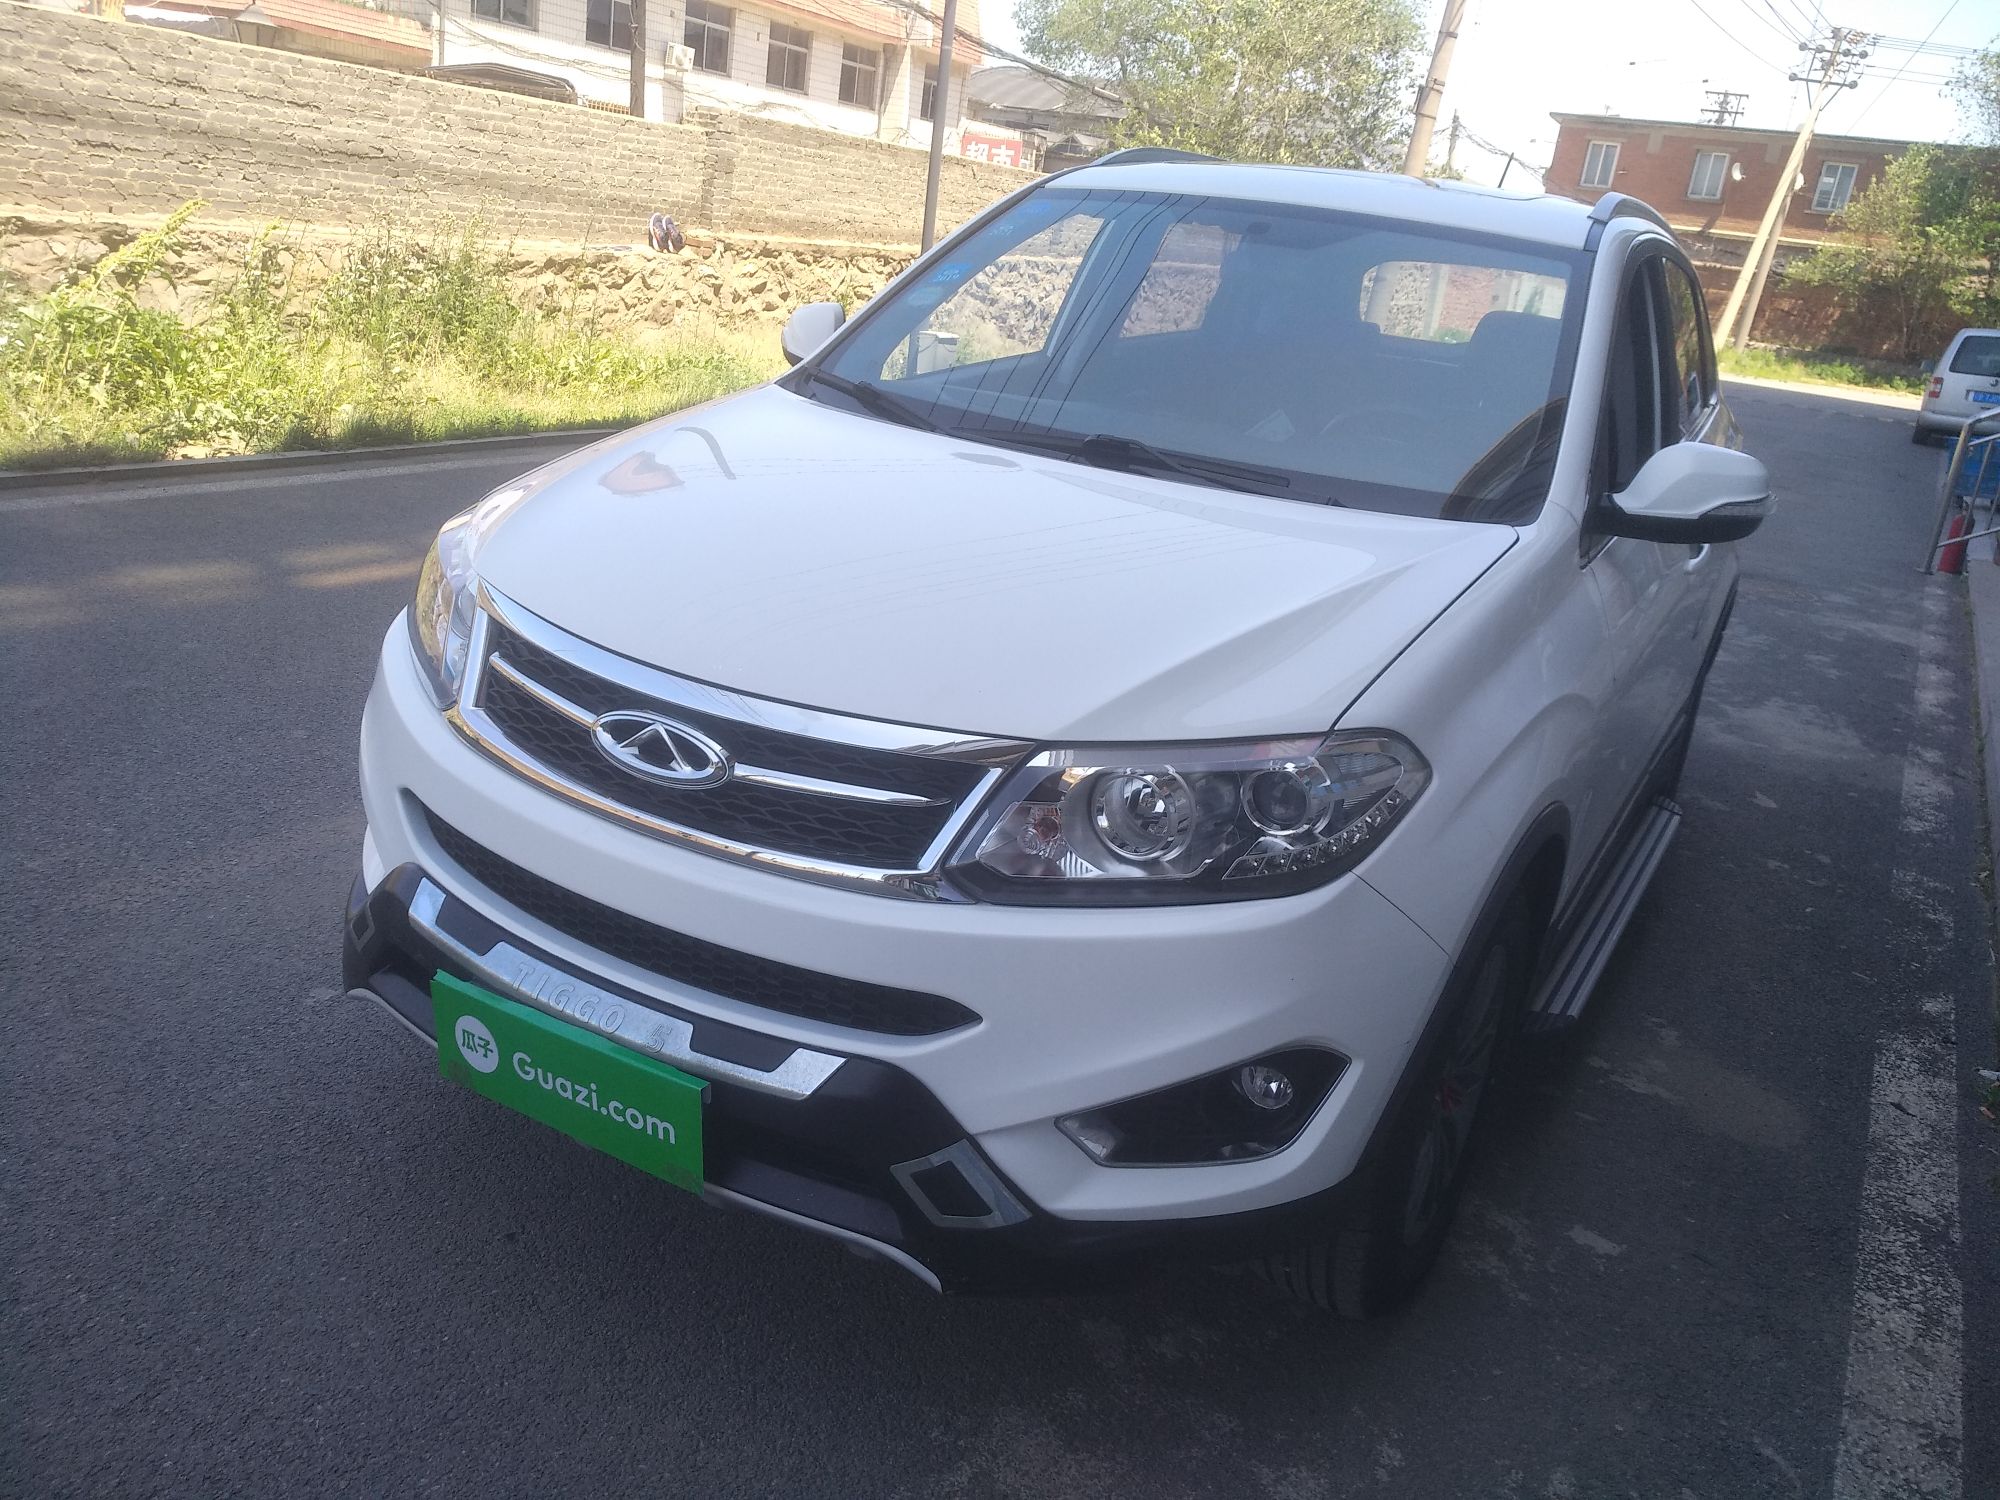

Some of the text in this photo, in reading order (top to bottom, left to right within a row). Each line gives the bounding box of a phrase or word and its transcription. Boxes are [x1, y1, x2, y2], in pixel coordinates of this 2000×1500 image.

[461, 1029, 493, 1058] 瓜子
[512, 961, 672, 1053] TIGGO 5
[512, 1051, 676, 1145] Guazi.com
